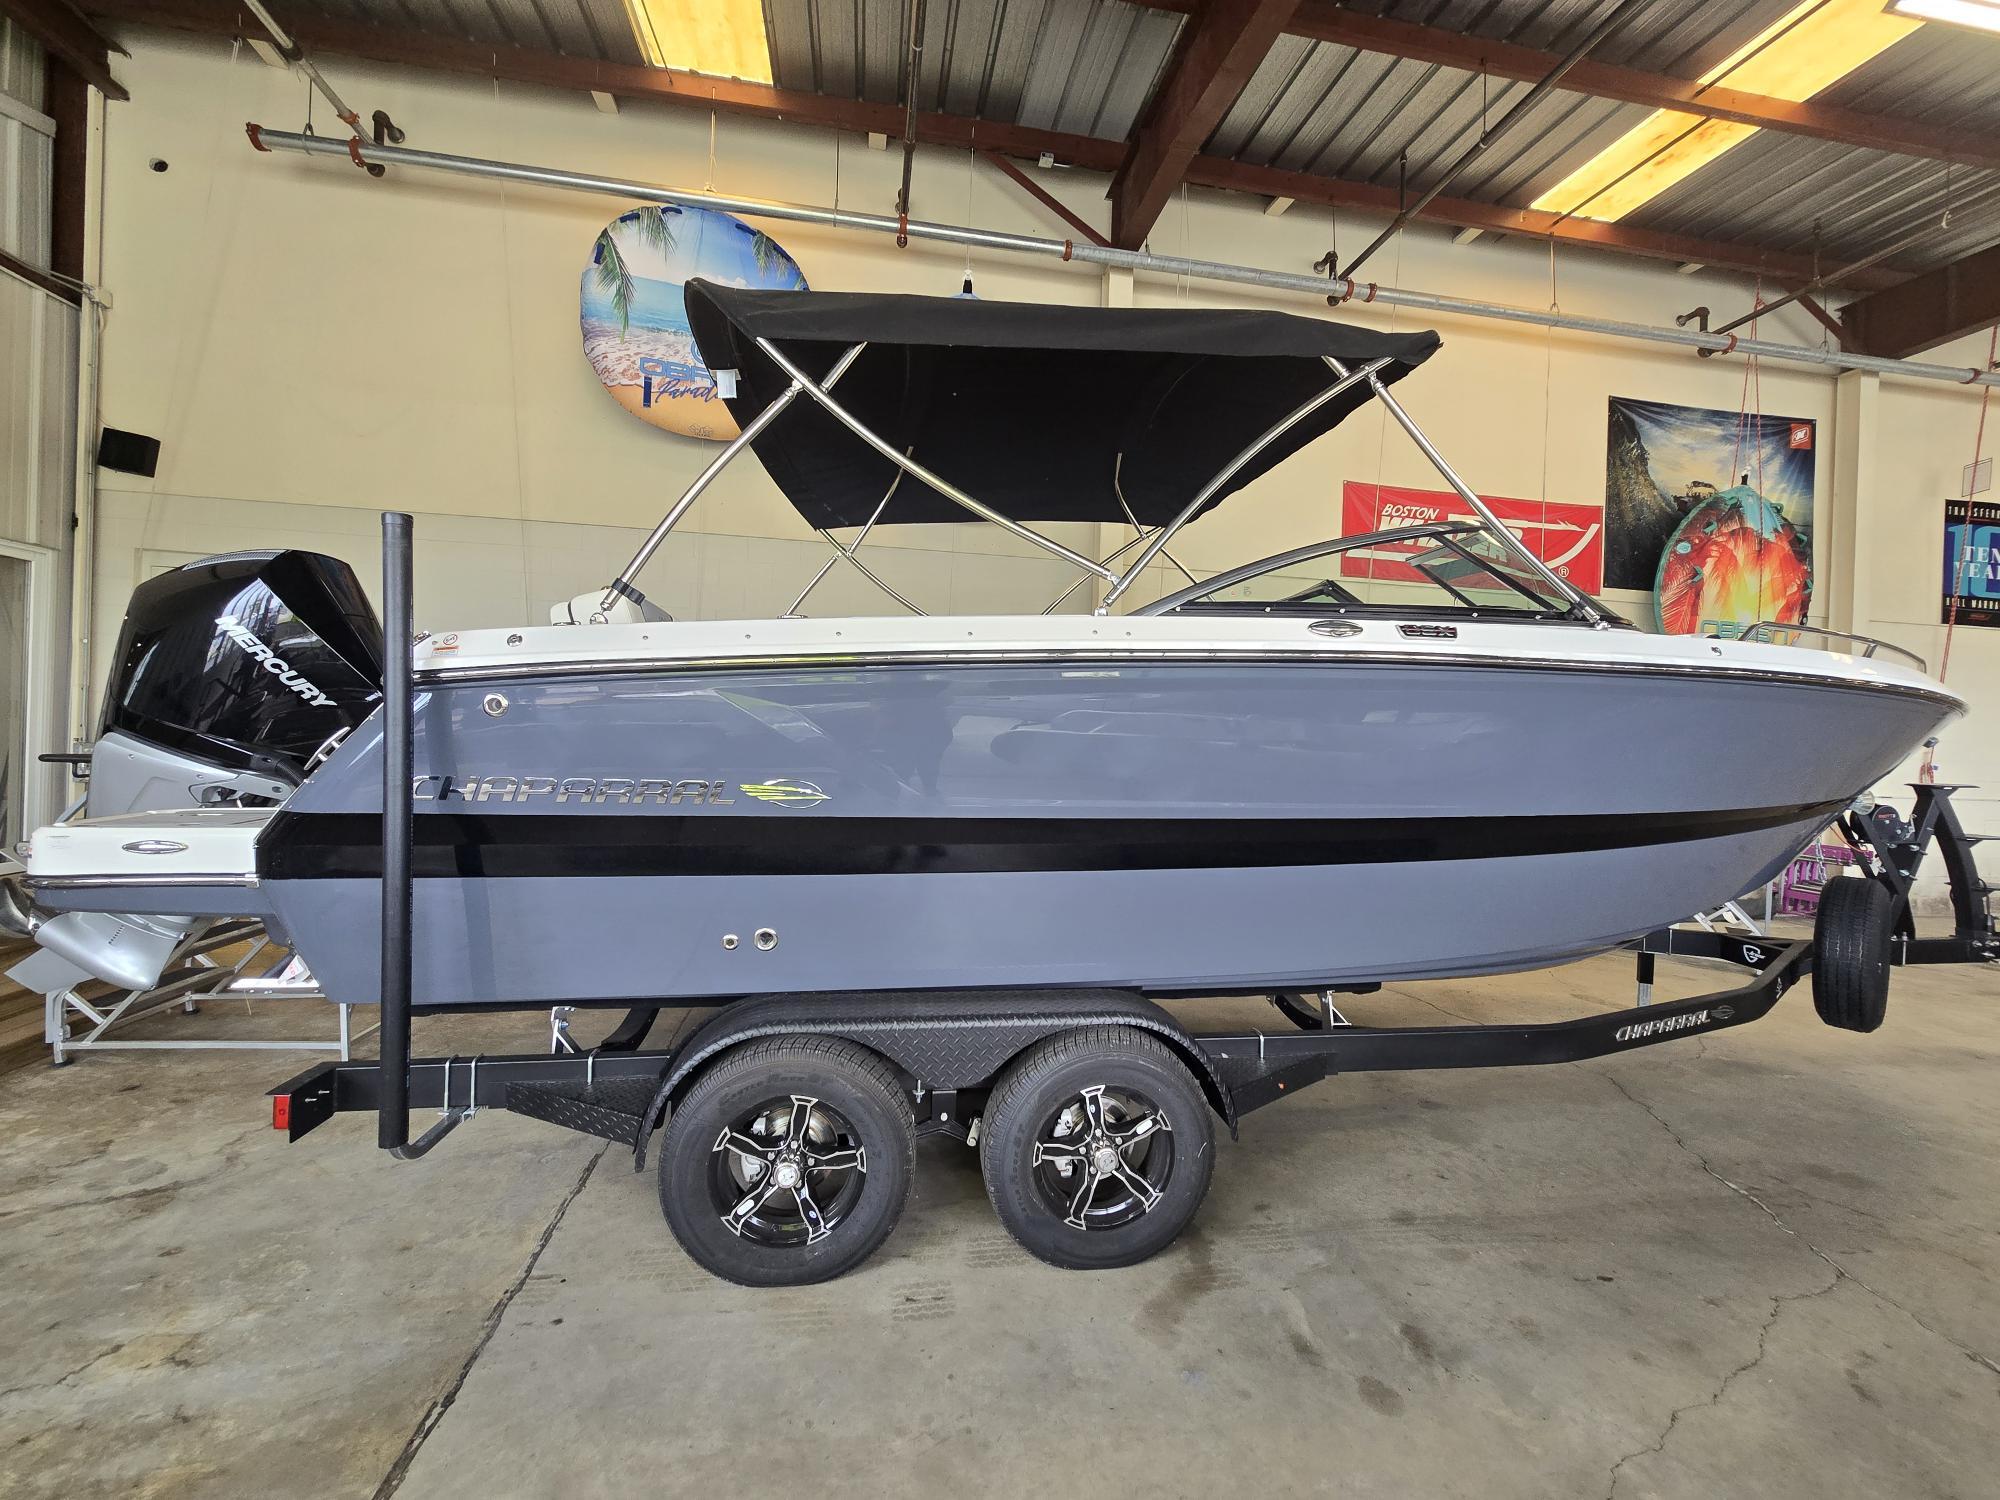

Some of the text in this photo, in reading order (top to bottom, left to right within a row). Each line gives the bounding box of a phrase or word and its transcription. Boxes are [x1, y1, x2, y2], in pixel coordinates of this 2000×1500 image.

[1382, 503, 1440, 520] BOSTON
[214, 614, 338, 708] MERCURY
[413, 775, 736, 806] CHAPARRAL
[1615, 1009, 1711, 1042] CHAPARRAL
